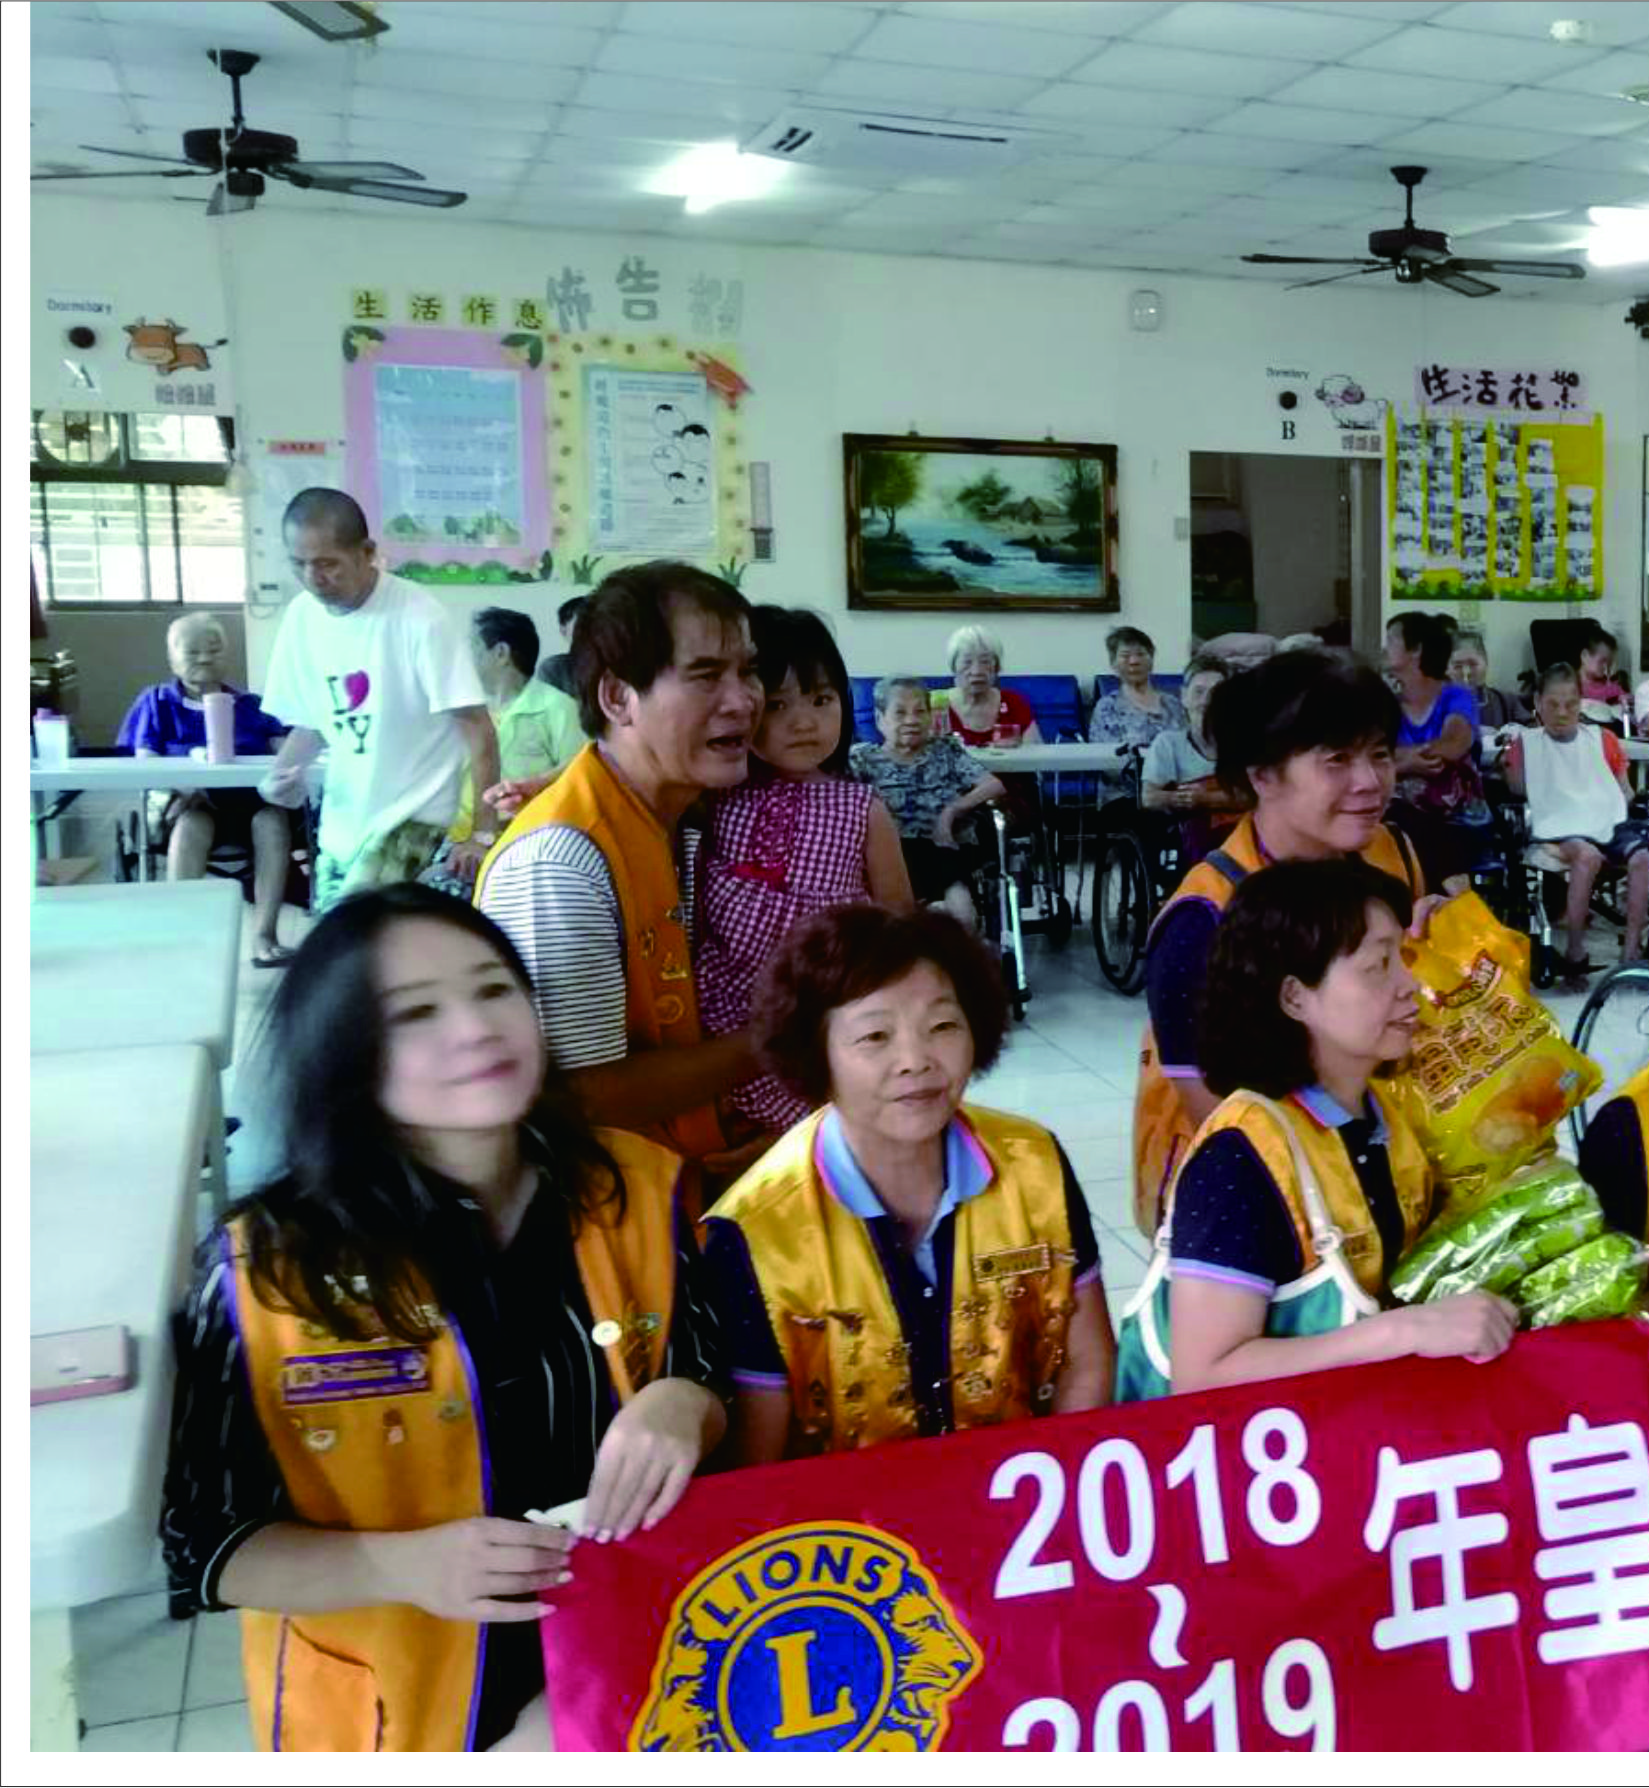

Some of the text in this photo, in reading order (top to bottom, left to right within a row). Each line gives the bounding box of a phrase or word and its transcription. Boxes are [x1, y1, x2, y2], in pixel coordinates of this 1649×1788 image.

[353, 290, 543, 330] 生活作息
[1421, 364, 1580, 410] 生活花絮
[1281, 421, 1296, 440] B
[988, 1406, 1322, 1600] 2018
[702, 1545, 891, 1628] LIONS
[765, 1630, 856, 1740] L
